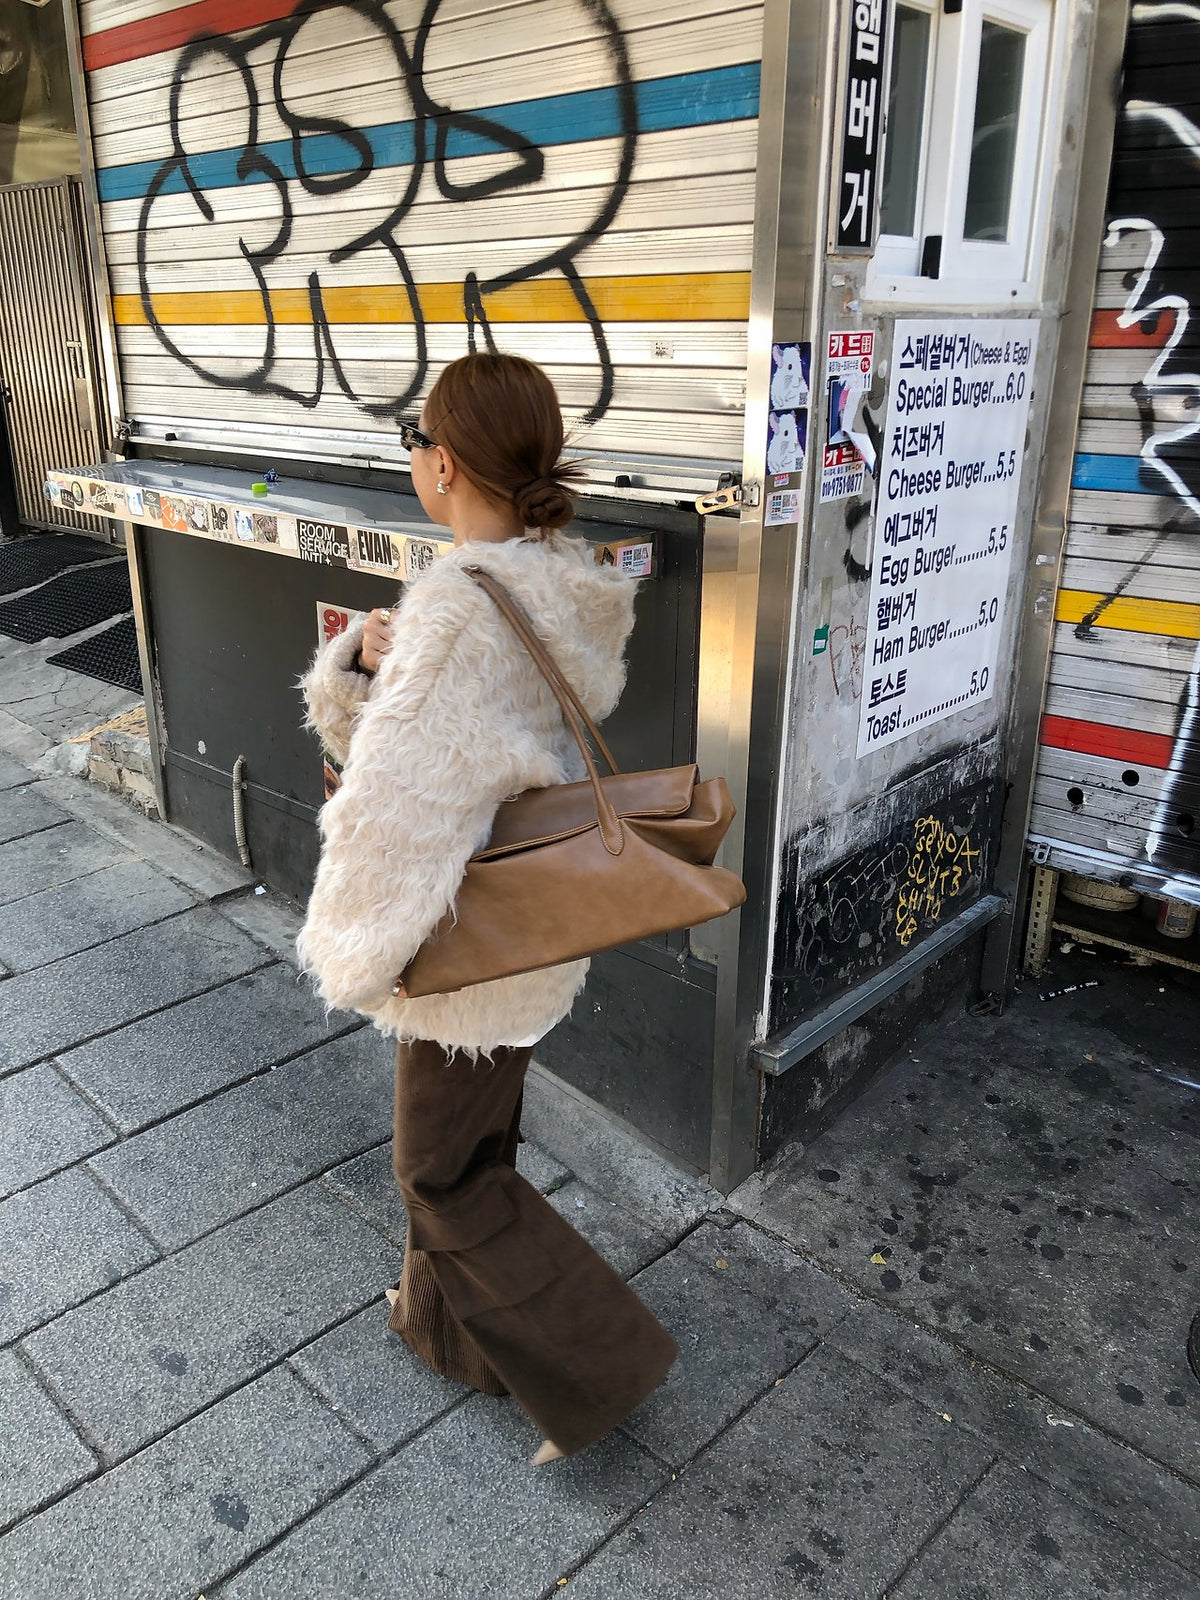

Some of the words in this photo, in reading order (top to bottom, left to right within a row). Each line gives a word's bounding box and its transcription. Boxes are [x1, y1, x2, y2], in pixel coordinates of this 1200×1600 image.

[841, 0, 882, 243] 햄버거
[1012, 338, 1032, 366] Egg)
[896, 377, 948, 416] Special
[891, 421, 945, 462] 치즈버거
[888, 467, 940, 500] Cheese
[299, 521, 336, 542] ROOM
[884, 504, 938, 548] 에그버거
[299, 536, 348, 558] SERVICE
[357, 530, 393, 565] EVAN
[880, 555, 909, 587] Egg
[877, 588, 917, 632] 햄버거
[873, 636, 903, 667] Ham
[868, 668, 908, 710] 토스트
